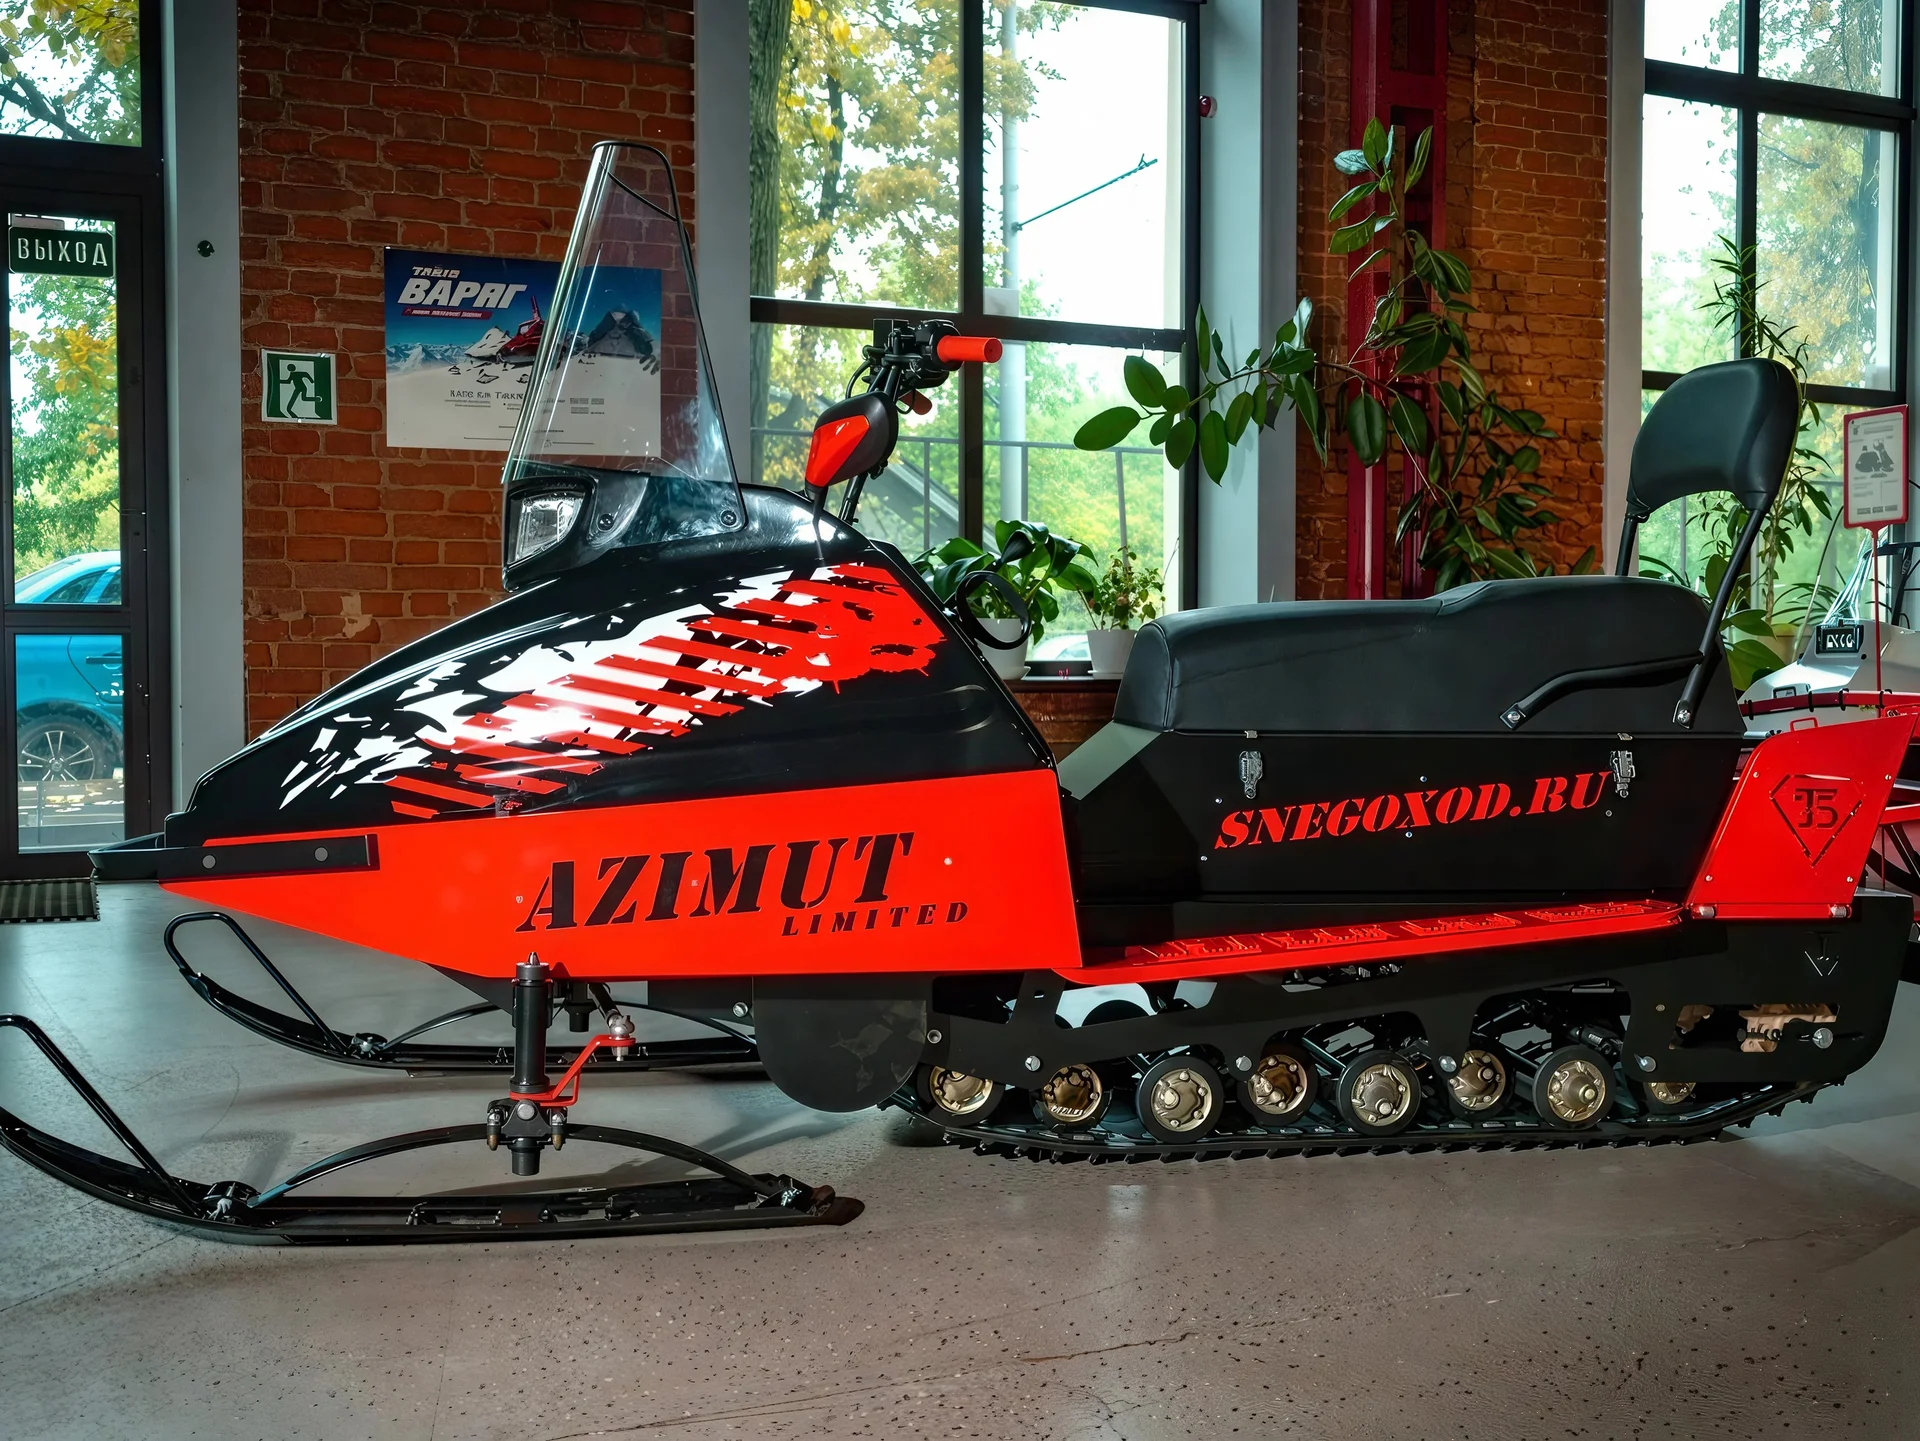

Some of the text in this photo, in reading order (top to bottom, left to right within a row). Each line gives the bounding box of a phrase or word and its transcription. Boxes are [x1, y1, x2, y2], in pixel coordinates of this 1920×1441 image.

[17, 237, 108, 266] ВЫХОД
[1213, 770, 1612, 850] SNEGOXOD.RU
[514, 831, 915, 932] AZIMUT
[781, 901, 969, 936] LIMITED
